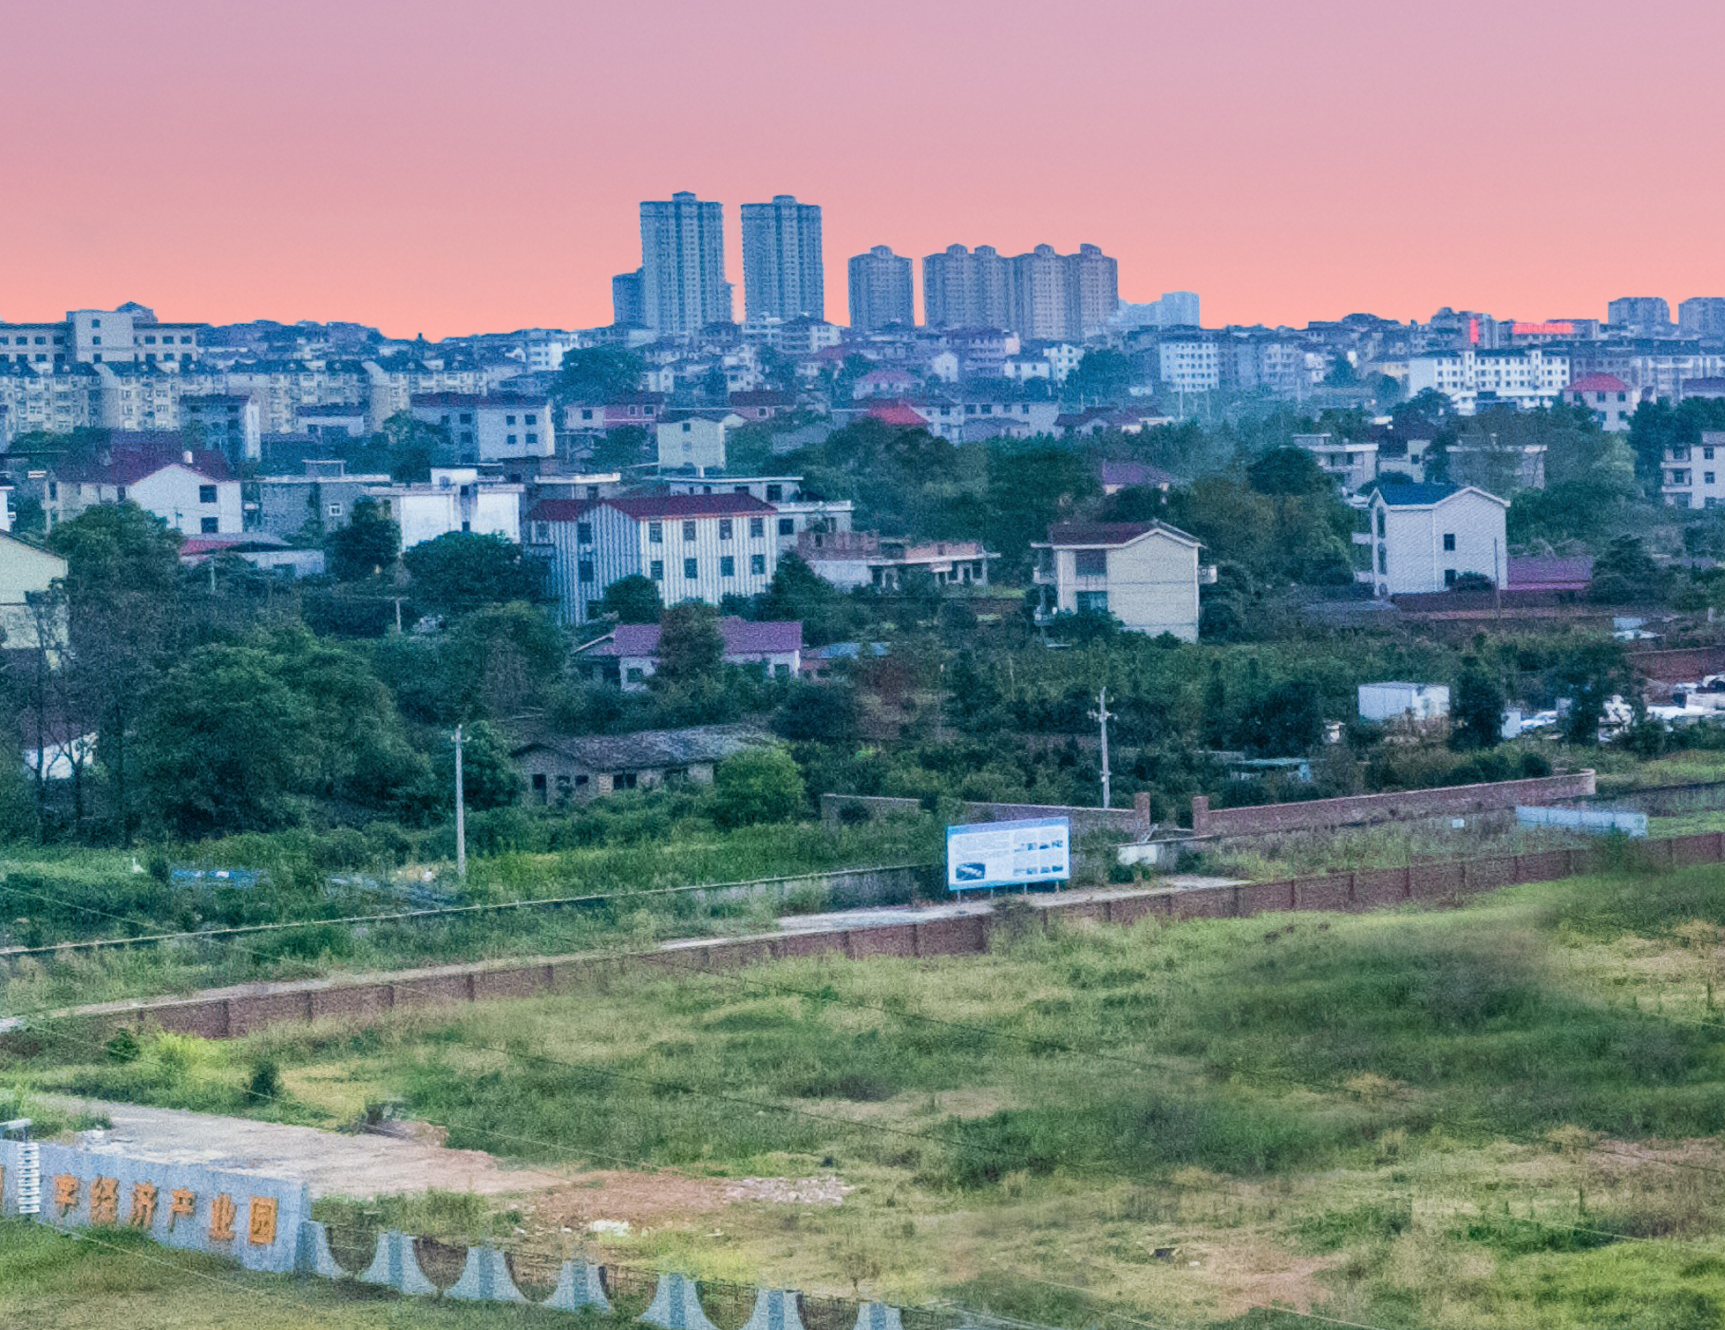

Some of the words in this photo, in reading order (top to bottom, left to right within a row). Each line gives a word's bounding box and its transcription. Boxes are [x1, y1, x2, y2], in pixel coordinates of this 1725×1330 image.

[0, 1165, 278, 1246] 字经济产业园
